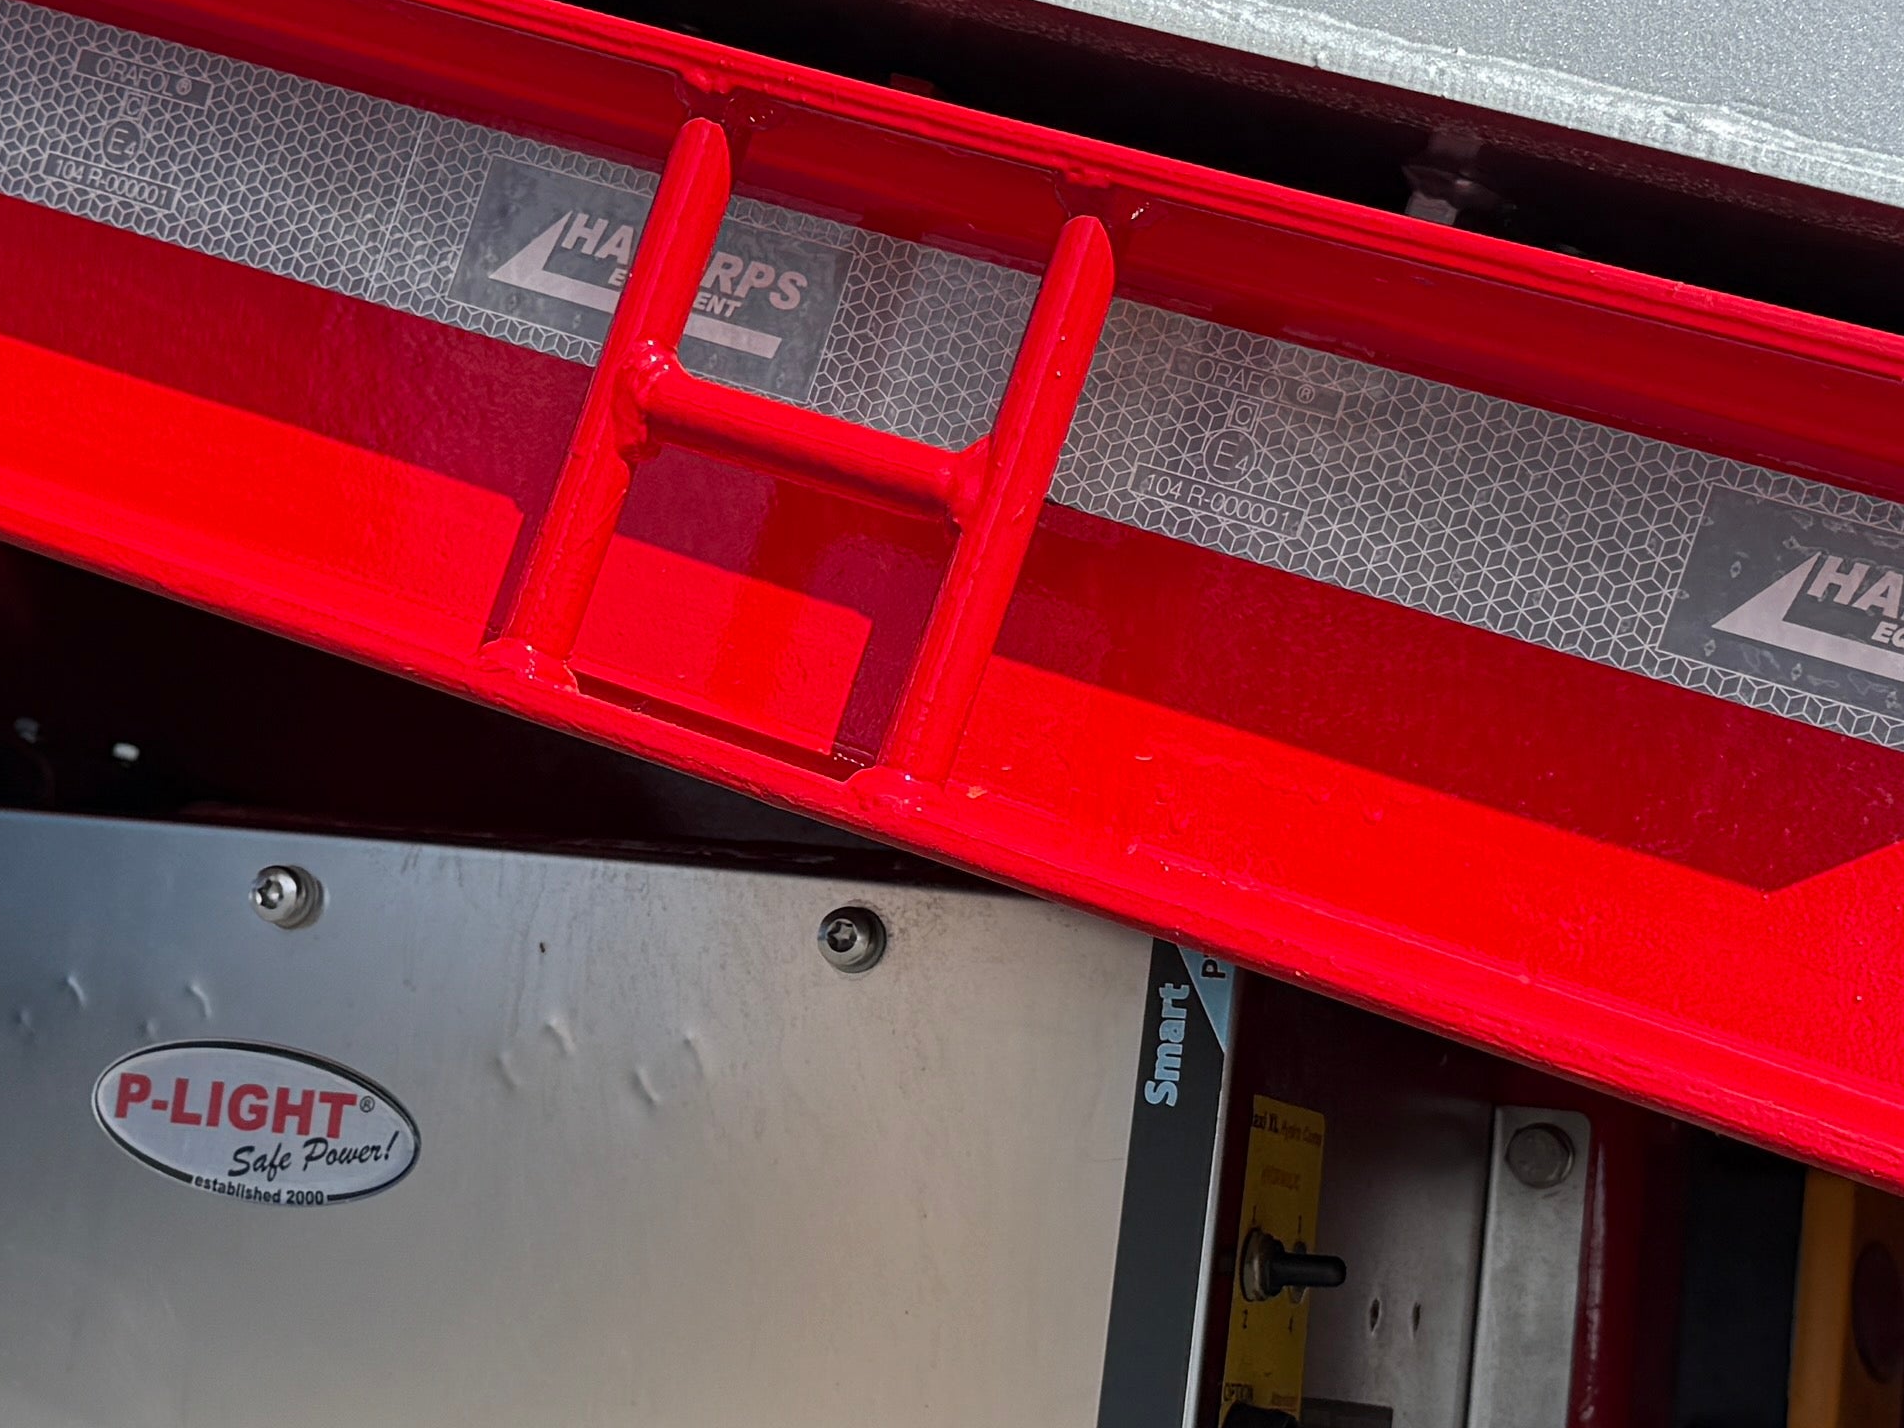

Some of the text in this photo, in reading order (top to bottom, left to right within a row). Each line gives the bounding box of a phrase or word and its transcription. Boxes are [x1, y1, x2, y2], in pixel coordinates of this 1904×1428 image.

[126, 96, 142, 116] C
[56, 158, 169, 209] 104 R-000001
[561, 212, 809, 311] HARPS
[1146, 474, 1291, 532] 104 R-000001
[1144, 982, 1190, 1108] Smart
[227, 1129, 400, 1182] Safe Power!
[194, 1175, 325, 1205] established 2000
